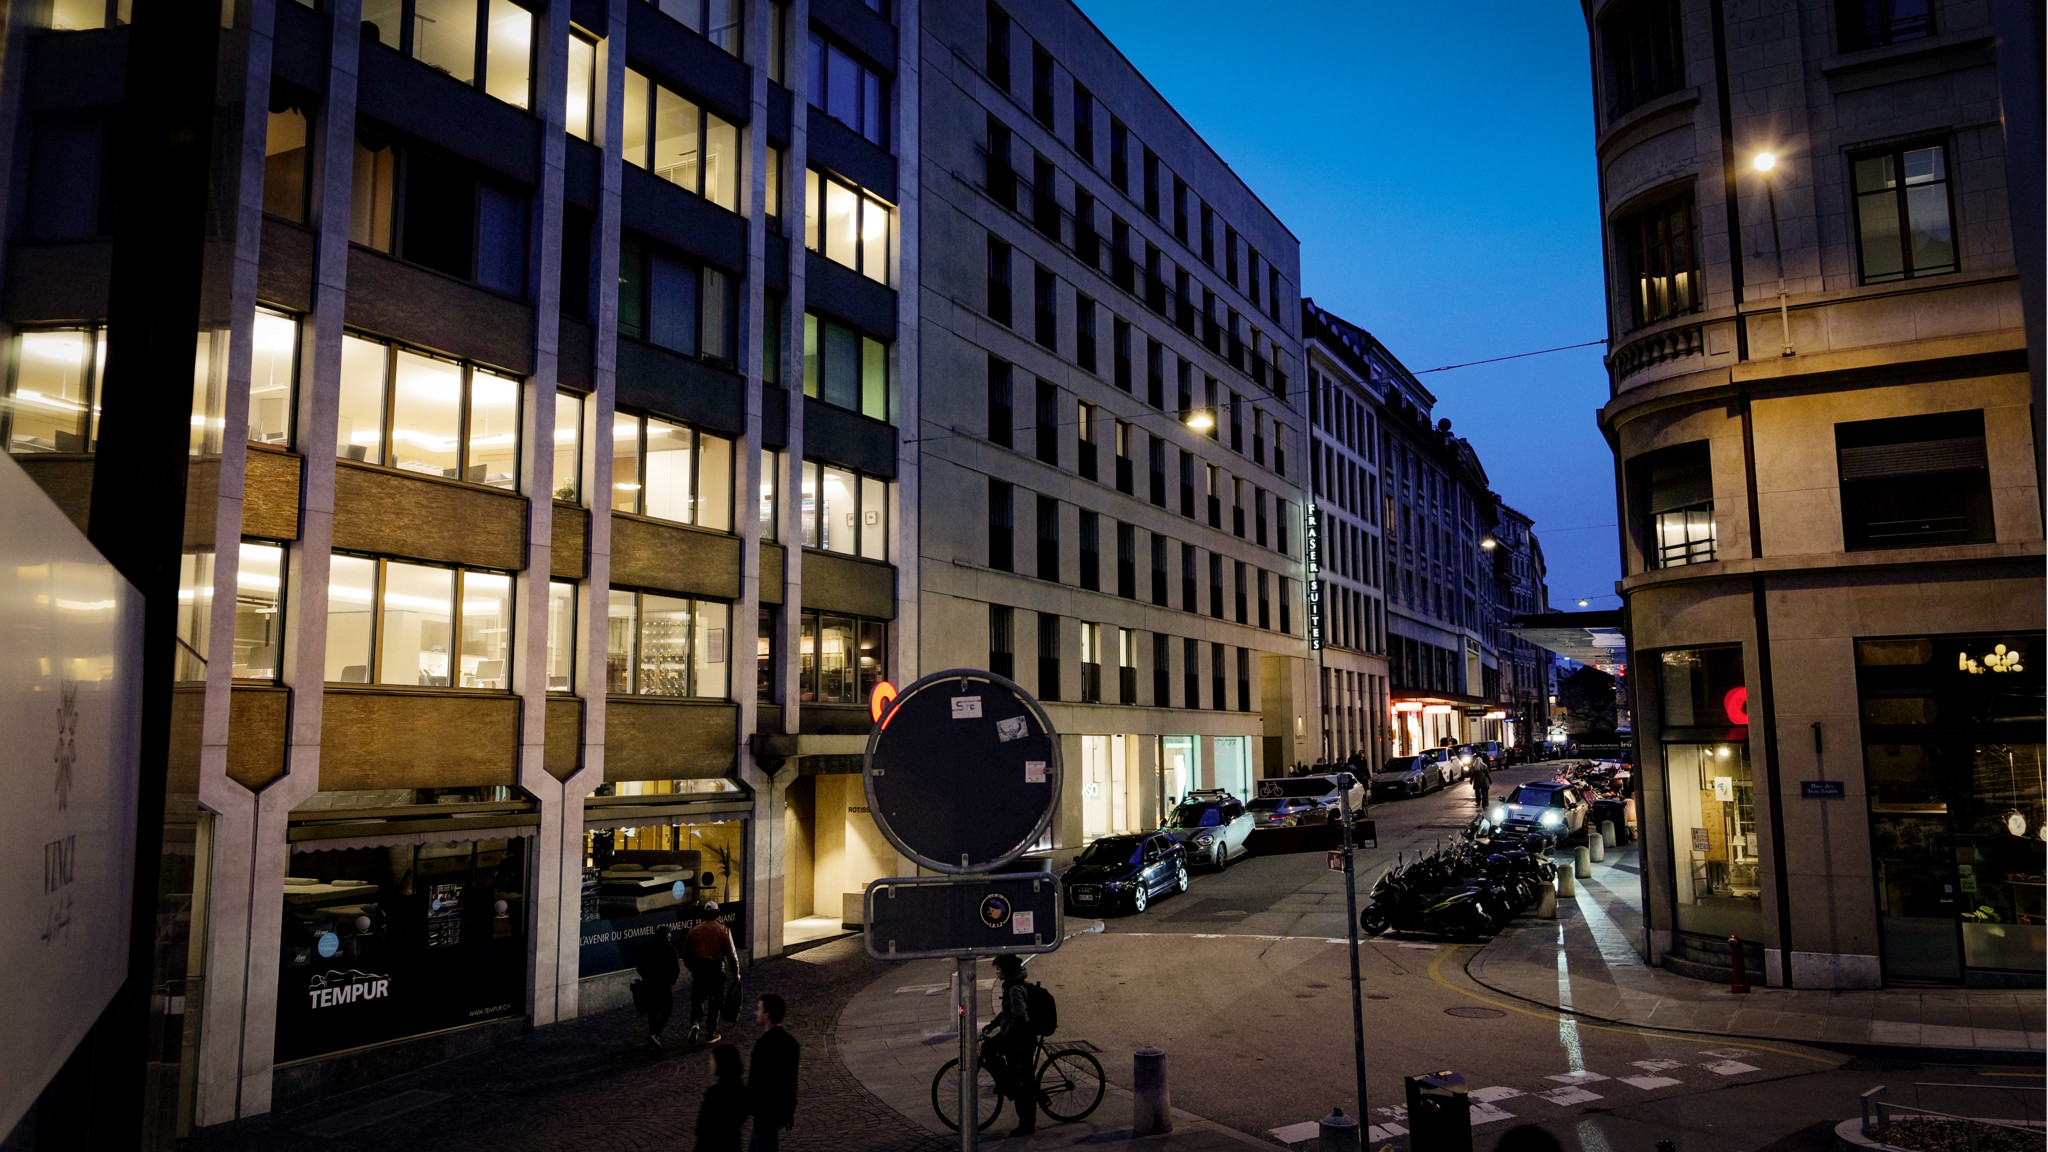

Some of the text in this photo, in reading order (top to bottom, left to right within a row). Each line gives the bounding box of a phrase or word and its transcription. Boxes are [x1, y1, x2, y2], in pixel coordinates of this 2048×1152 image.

[1307, 504, 1320, 650] FRASER SUITES
[612, 930, 622, 941] DU
[623, 926, 655, 939] SOMMEIL
[309, 979, 389, 1009] TEMPUR
